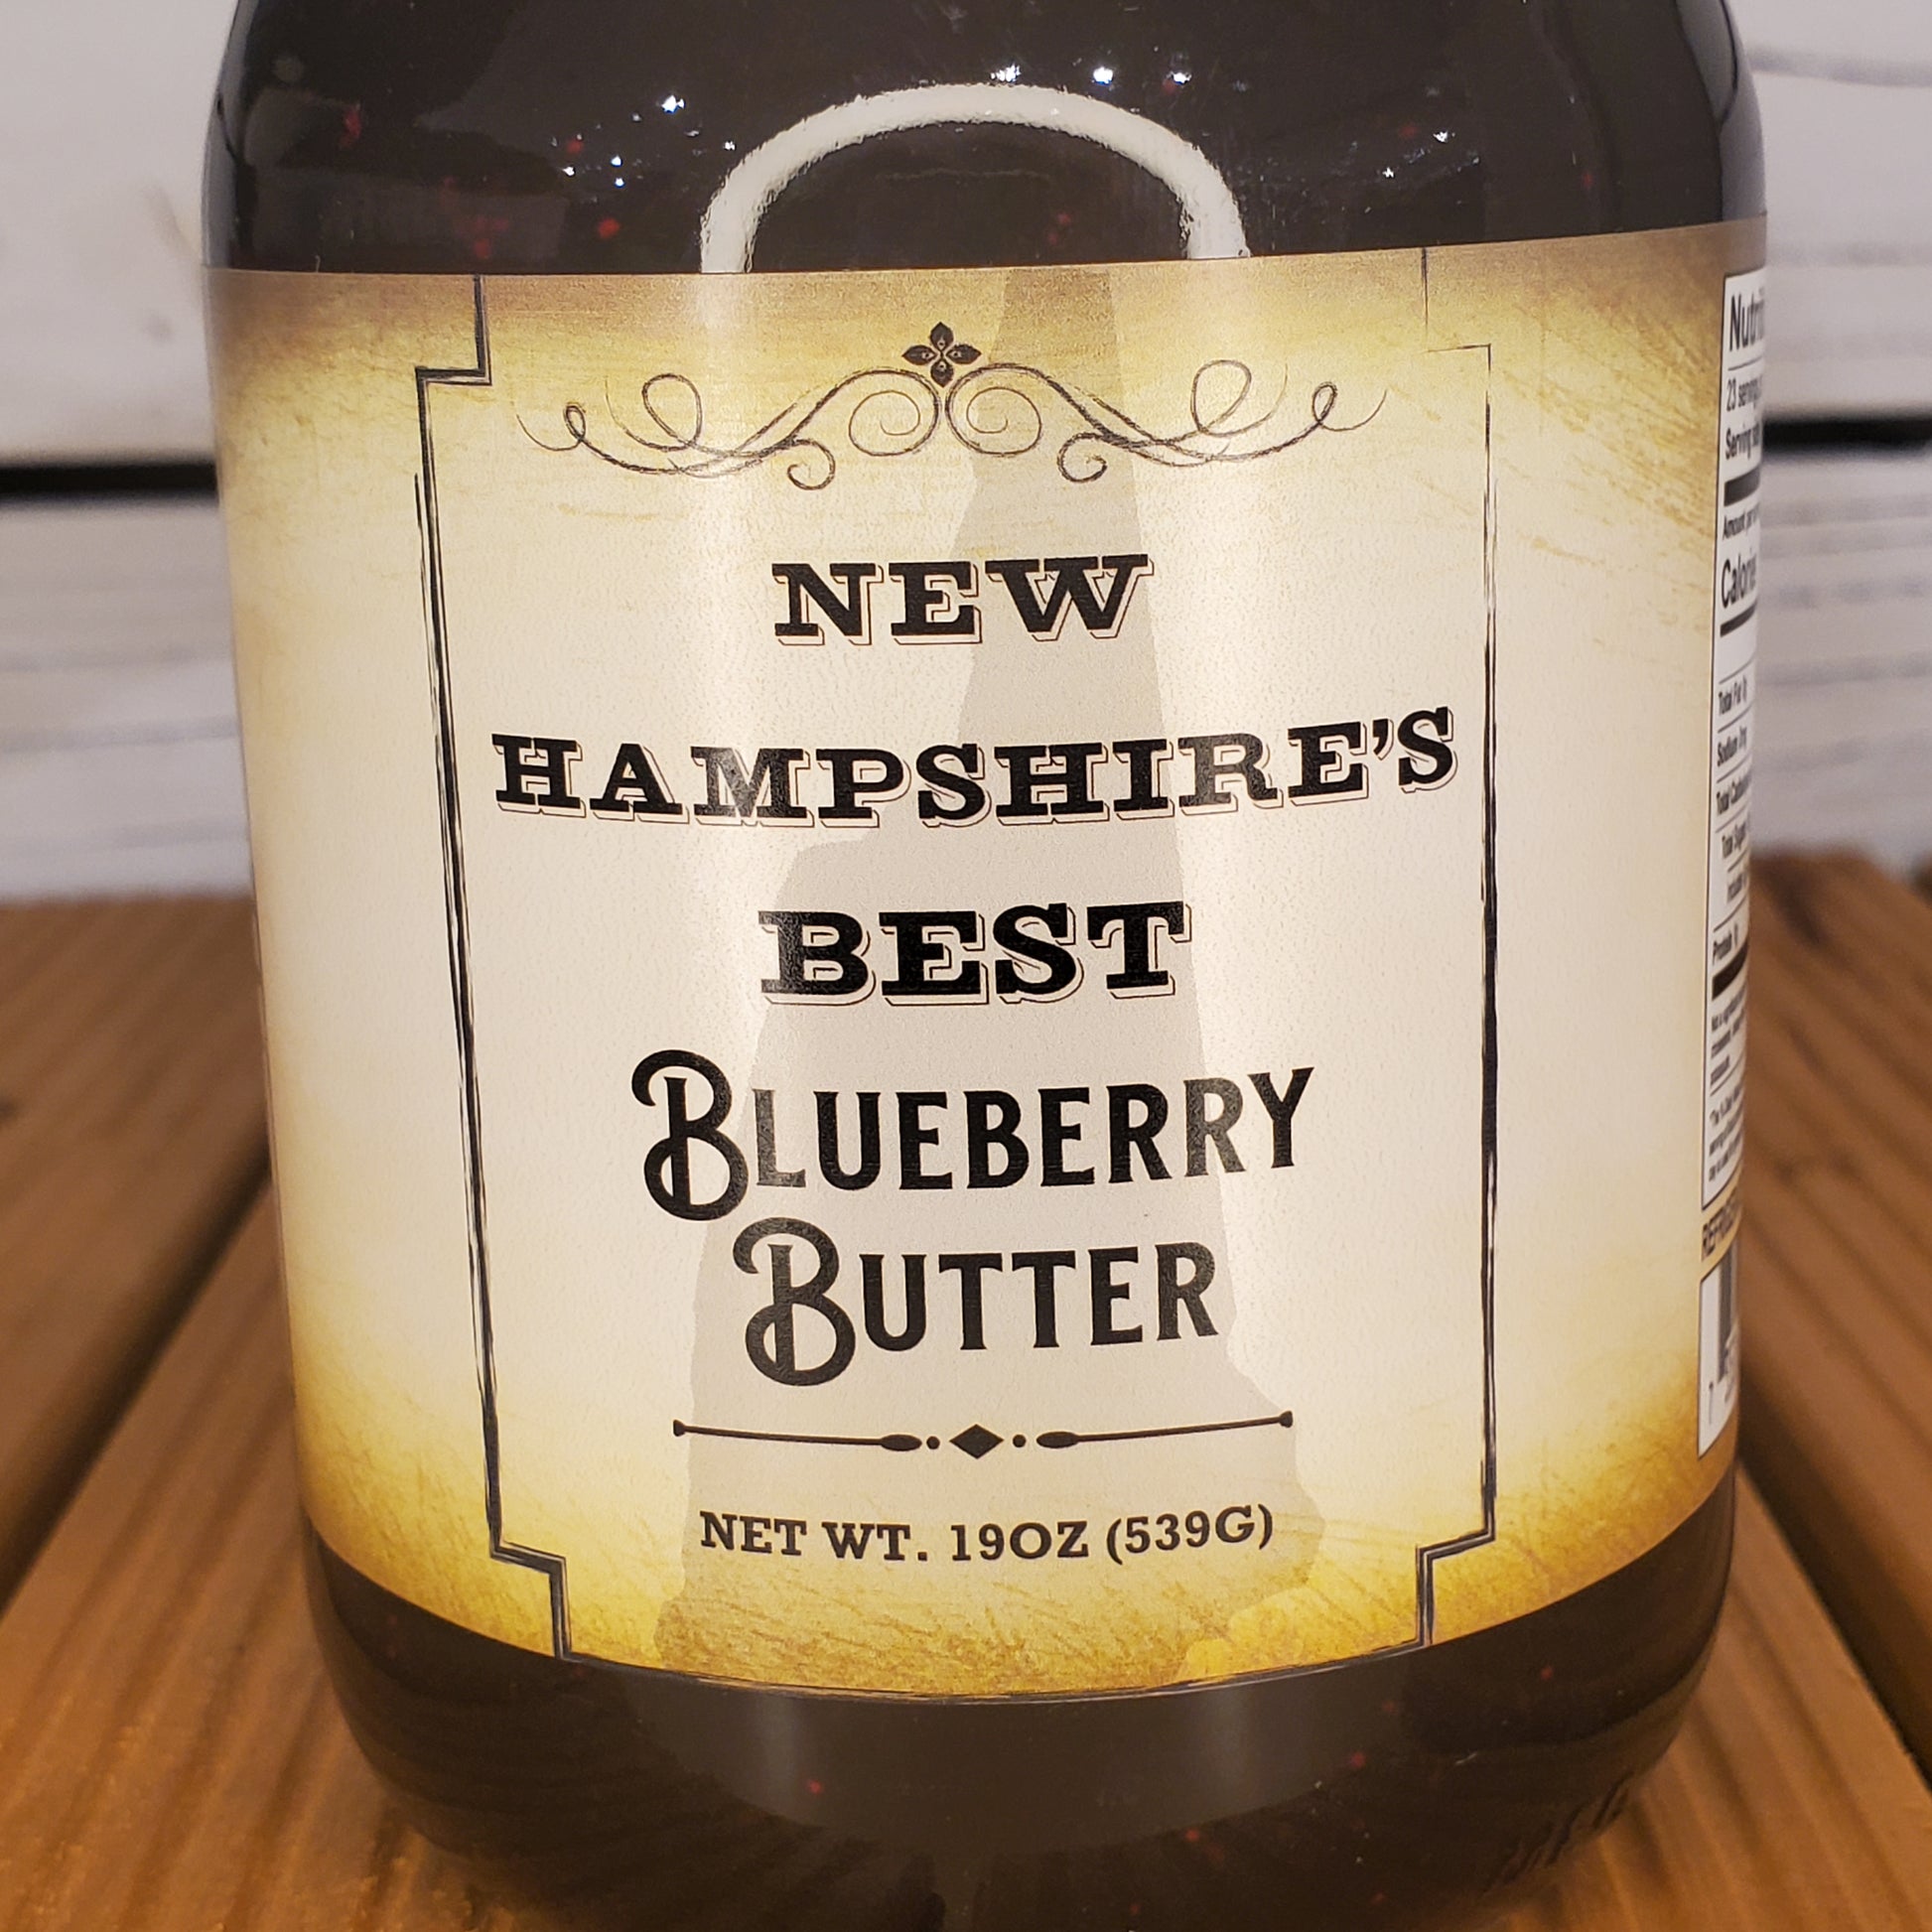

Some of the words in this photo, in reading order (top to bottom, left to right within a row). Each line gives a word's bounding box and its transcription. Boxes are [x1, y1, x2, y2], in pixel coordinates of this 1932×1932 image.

[772, 554, 1154, 645] NEW
[491, 707, 1453, 828] HAMPSHIRE'S
[759, 901, 1191, 1007] BEST
[700, 1511, 806, 1556] NET
[822, 1522, 927, 1561] WT.
[1107, 1504, 1272, 1564] (539G)
